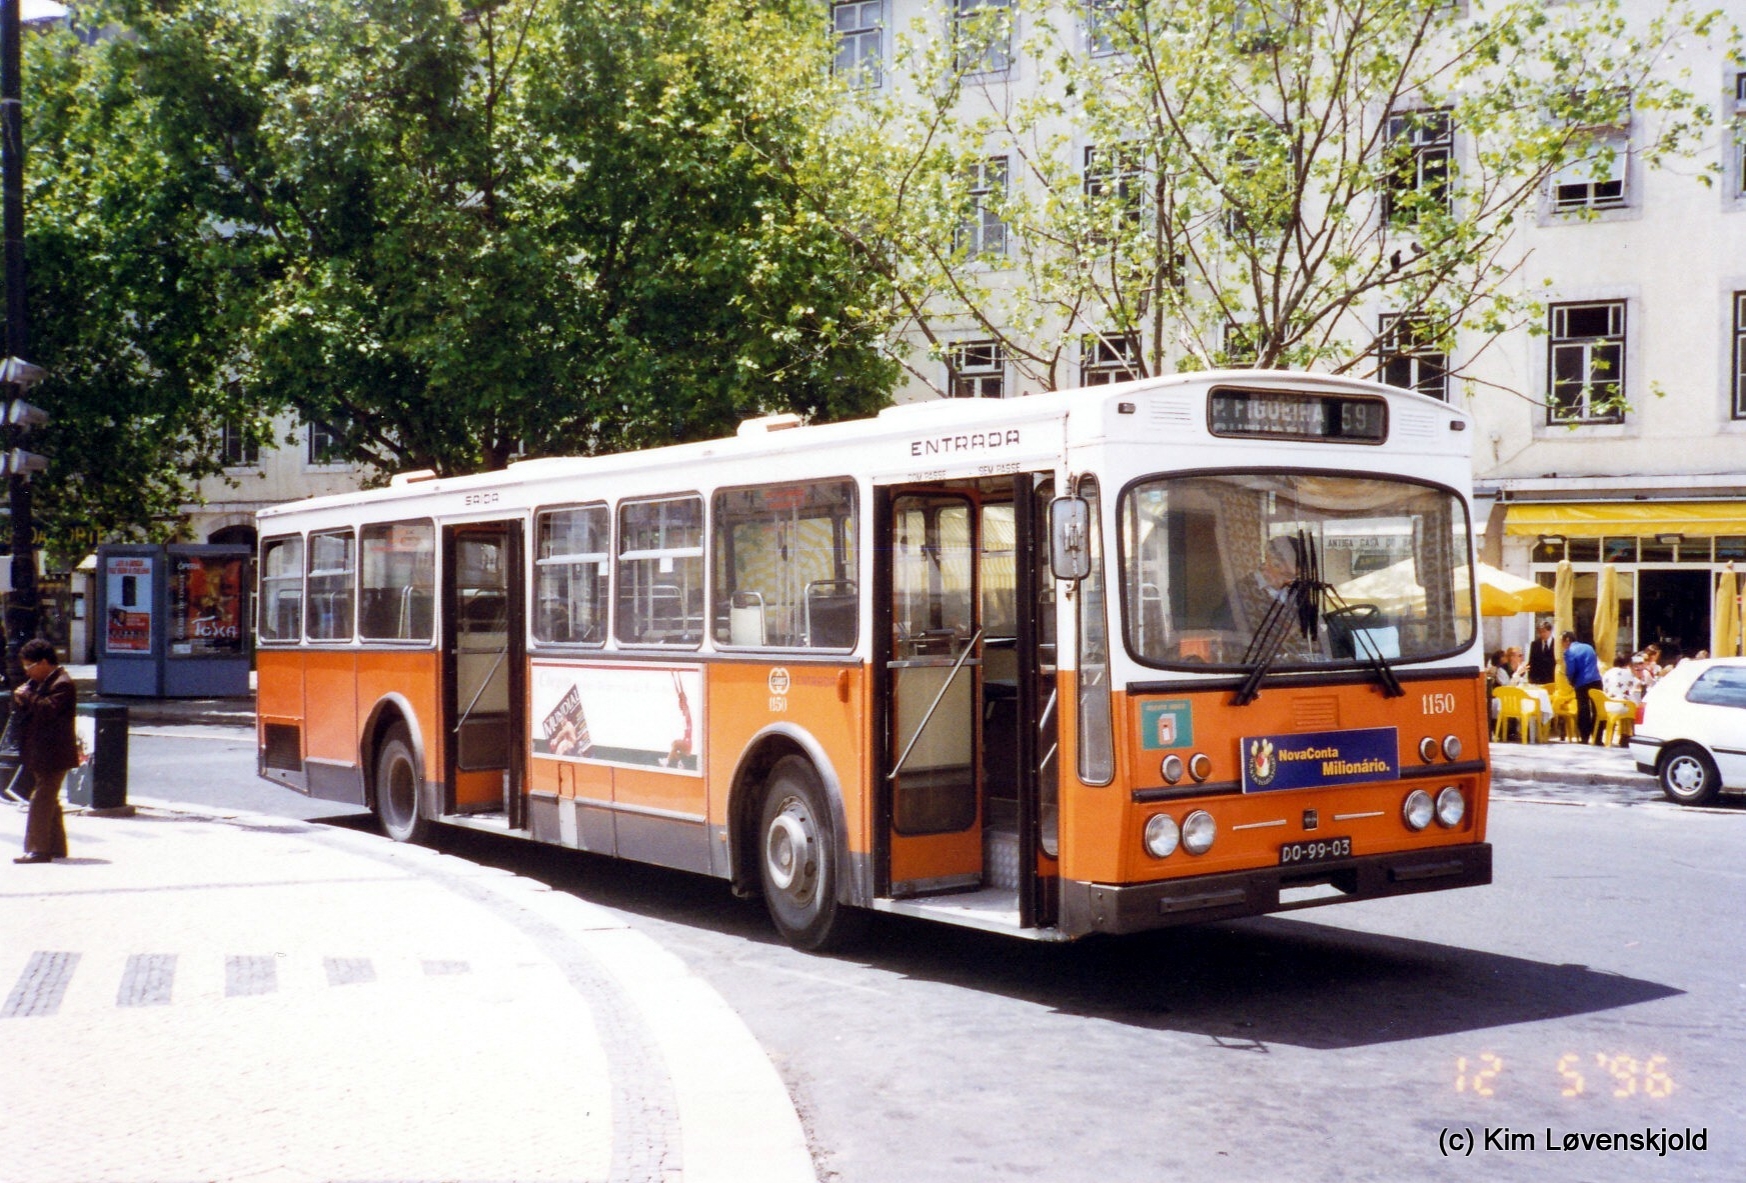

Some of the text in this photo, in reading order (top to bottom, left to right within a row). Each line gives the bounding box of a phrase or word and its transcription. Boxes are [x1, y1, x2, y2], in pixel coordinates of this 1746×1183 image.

[1234, 399, 1324, 422] FIGUEIRA
[1341, 403, 1366, 430] 59
[910, 429, 1021, 457] ENTRADA
[996, 462, 1021, 474] PASSE
[1421, 693, 1456, 715] 1150
[1278, 747, 1339, 761] NovaConta
[1322, 758, 1391, 776] Milionário.
[1282, 839, 1350, 863] DO-99-03
